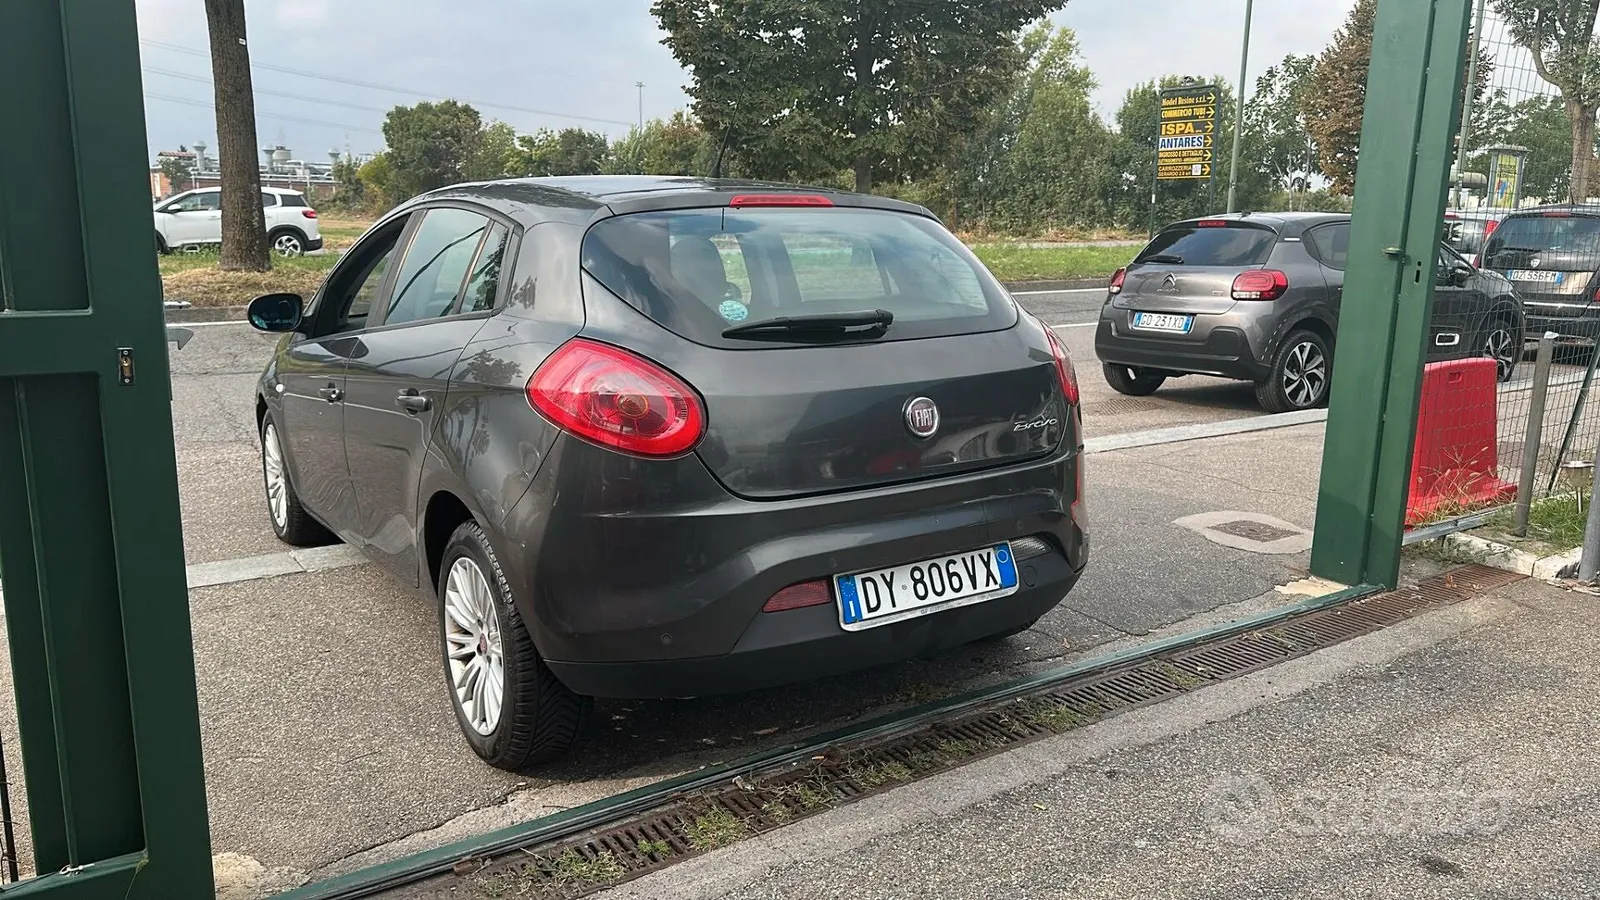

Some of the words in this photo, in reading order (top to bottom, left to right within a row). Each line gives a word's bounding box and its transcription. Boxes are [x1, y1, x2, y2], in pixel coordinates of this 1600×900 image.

[1161, 108, 1192, 118] COMMERCIO
[1193, 107, 1206, 116] TUBI
[1161, 122, 1194, 135] ISPA
[1160, 136, 1203, 148] ANTARES
[914, 407, 933, 428] FIAT
[1013, 418, 1058, 432] Bravo
[860, 571, 896, 614] DY
[909, 551, 999, 601] 806VX
